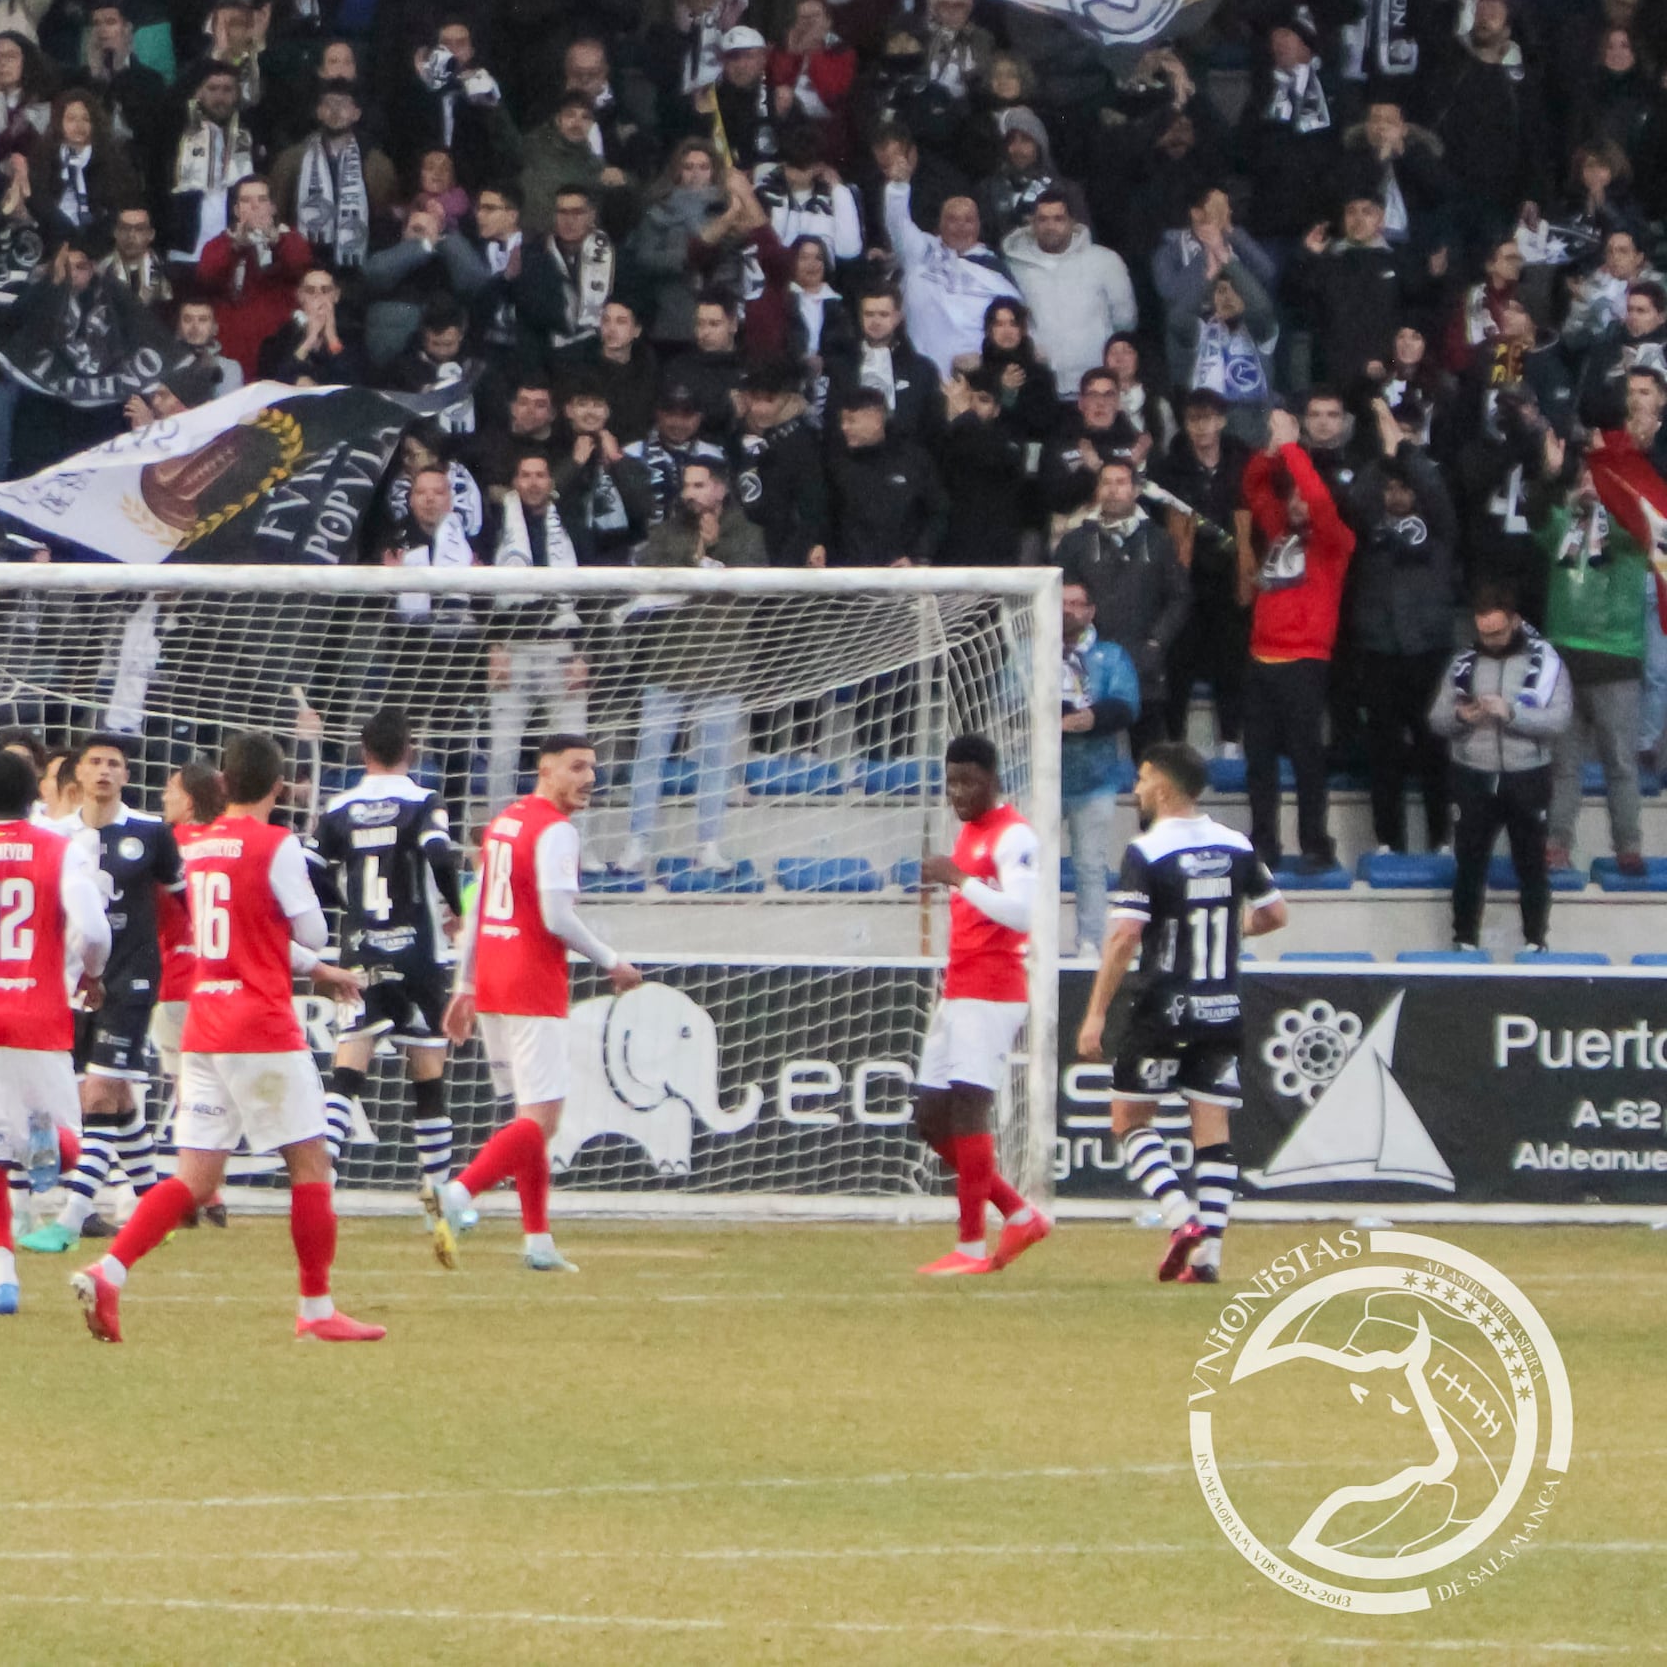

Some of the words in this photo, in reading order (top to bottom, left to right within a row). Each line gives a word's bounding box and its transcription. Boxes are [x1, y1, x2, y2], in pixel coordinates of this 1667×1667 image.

[362, 855, 394, 922] 4
[485, 838, 515, 921] 18
[190, 871, 232, 960] 16
[1188, 907, 1229, 981] 11
[1571, 1099, 1662, 1130] A-62
[1053, 1136, 1195, 1181] gruo
